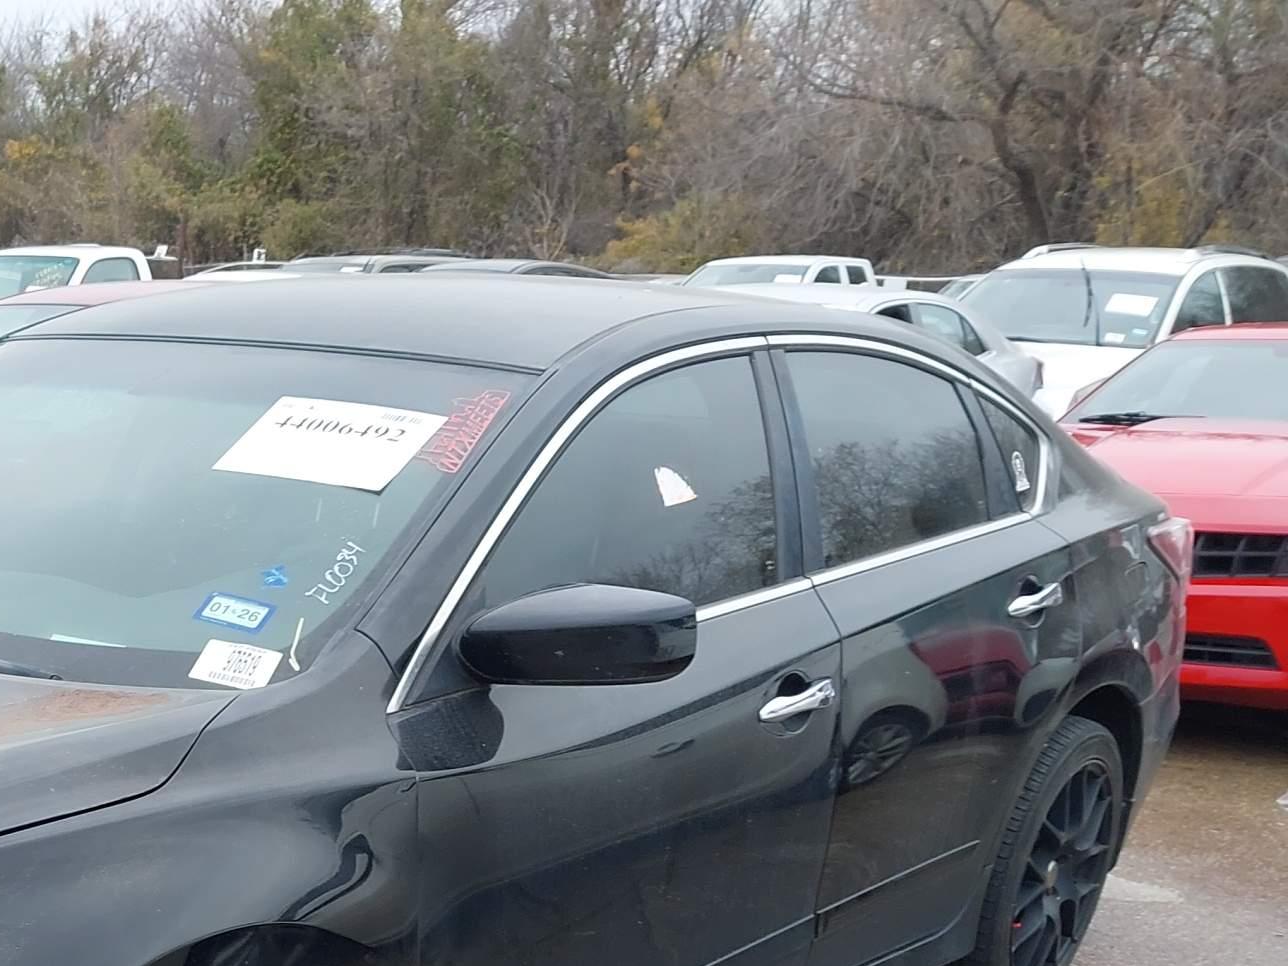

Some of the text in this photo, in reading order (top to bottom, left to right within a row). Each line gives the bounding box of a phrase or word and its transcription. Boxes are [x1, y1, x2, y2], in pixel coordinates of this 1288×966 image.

[275, 415, 407, 442] 44006492
[210, 602, 261, 622] 01 26
